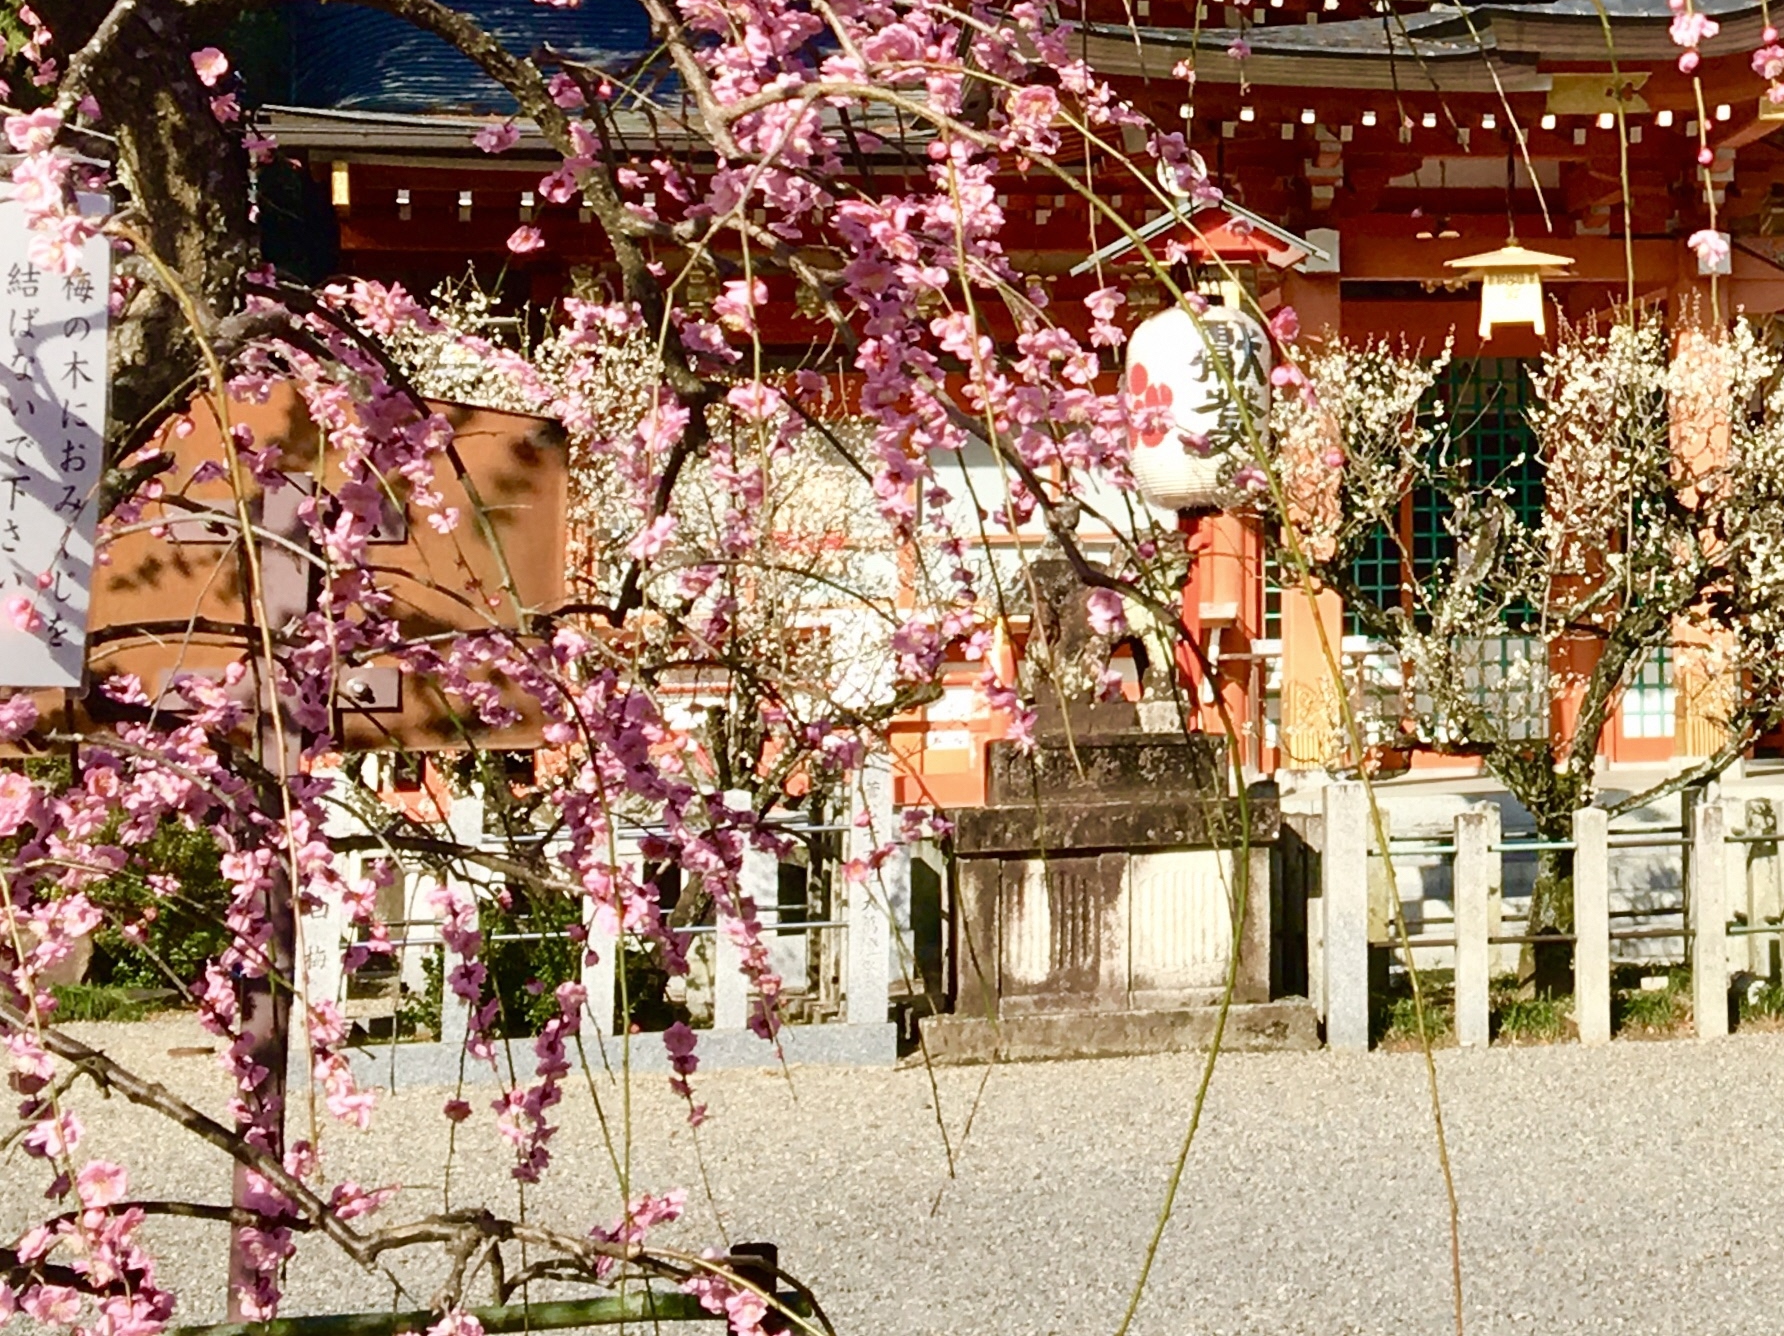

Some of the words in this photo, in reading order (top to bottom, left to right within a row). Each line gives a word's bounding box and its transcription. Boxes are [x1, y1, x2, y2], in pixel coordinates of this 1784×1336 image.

[0, 262, 41, 589] 結ばないで下さい
